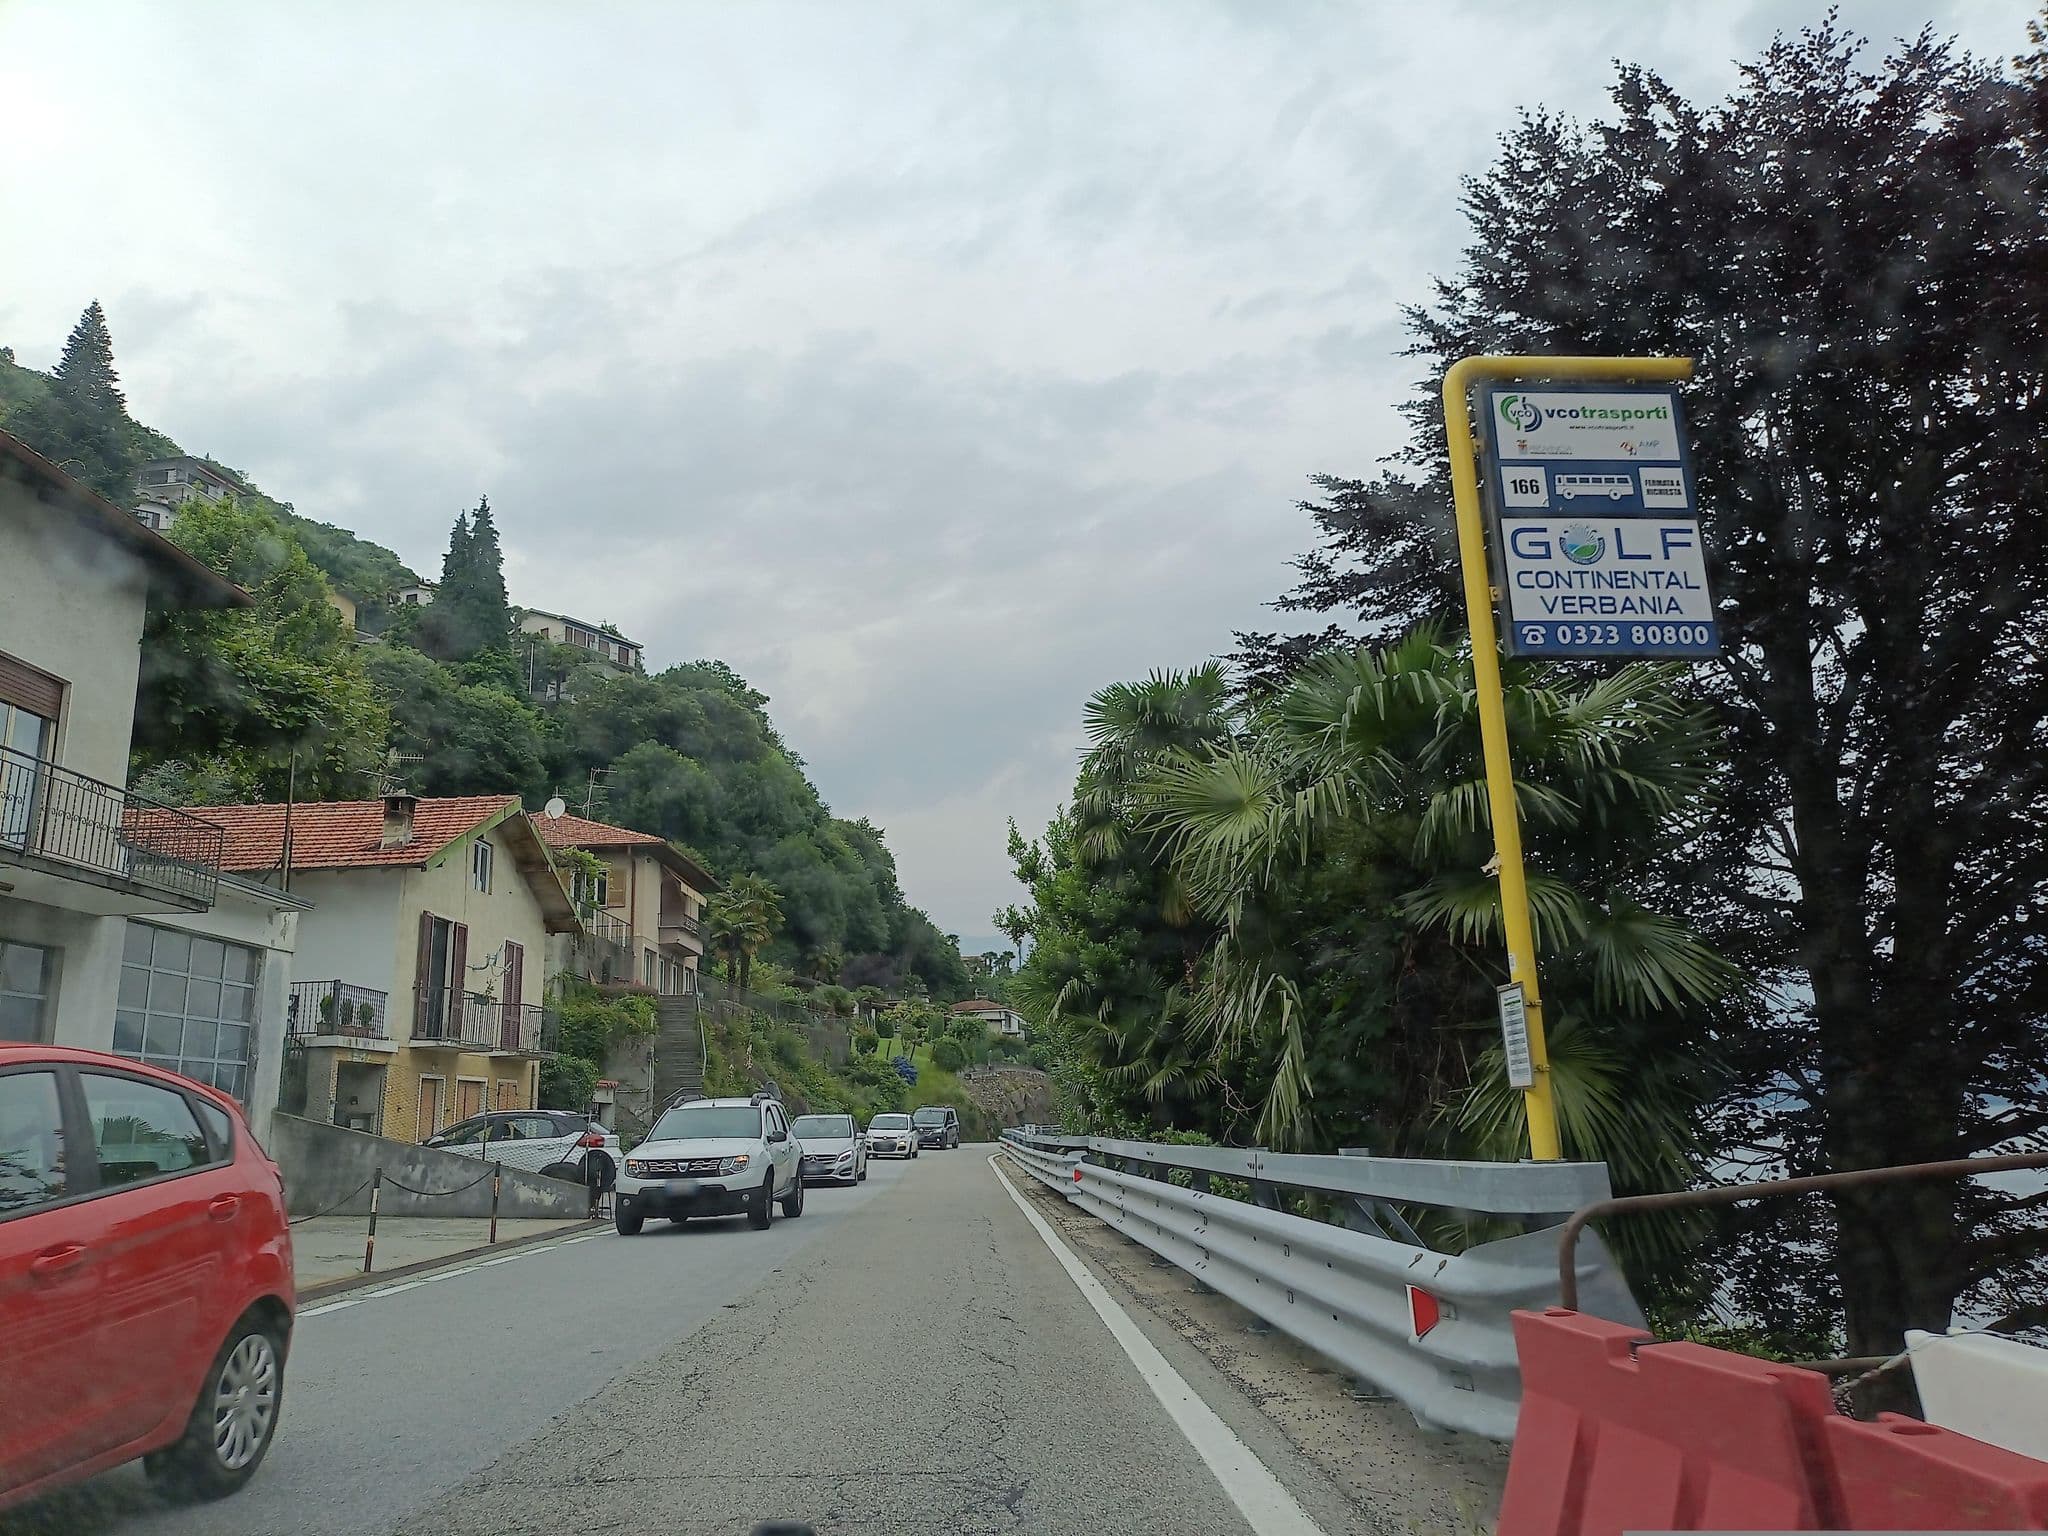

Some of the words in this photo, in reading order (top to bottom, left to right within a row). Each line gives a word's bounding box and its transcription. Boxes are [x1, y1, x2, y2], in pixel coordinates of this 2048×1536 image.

[1544, 405, 1668, 422] vcotrasporti
[1510, 478, 1541, 495] 166
[1644, 479, 1674, 487] FERMATA
[1675, 479, 1681, 487] A
[1646, 488, 1683, 496] RICHIESTA
[1510, 523, 1694, 565] GOLF
[1516, 570, 1701, 590] CONTINENTAL
[1540, 595, 1683, 615] VERBANIA
[1557, 625, 1620, 645] 0323
[1631, 625, 1709, 645] 80800
